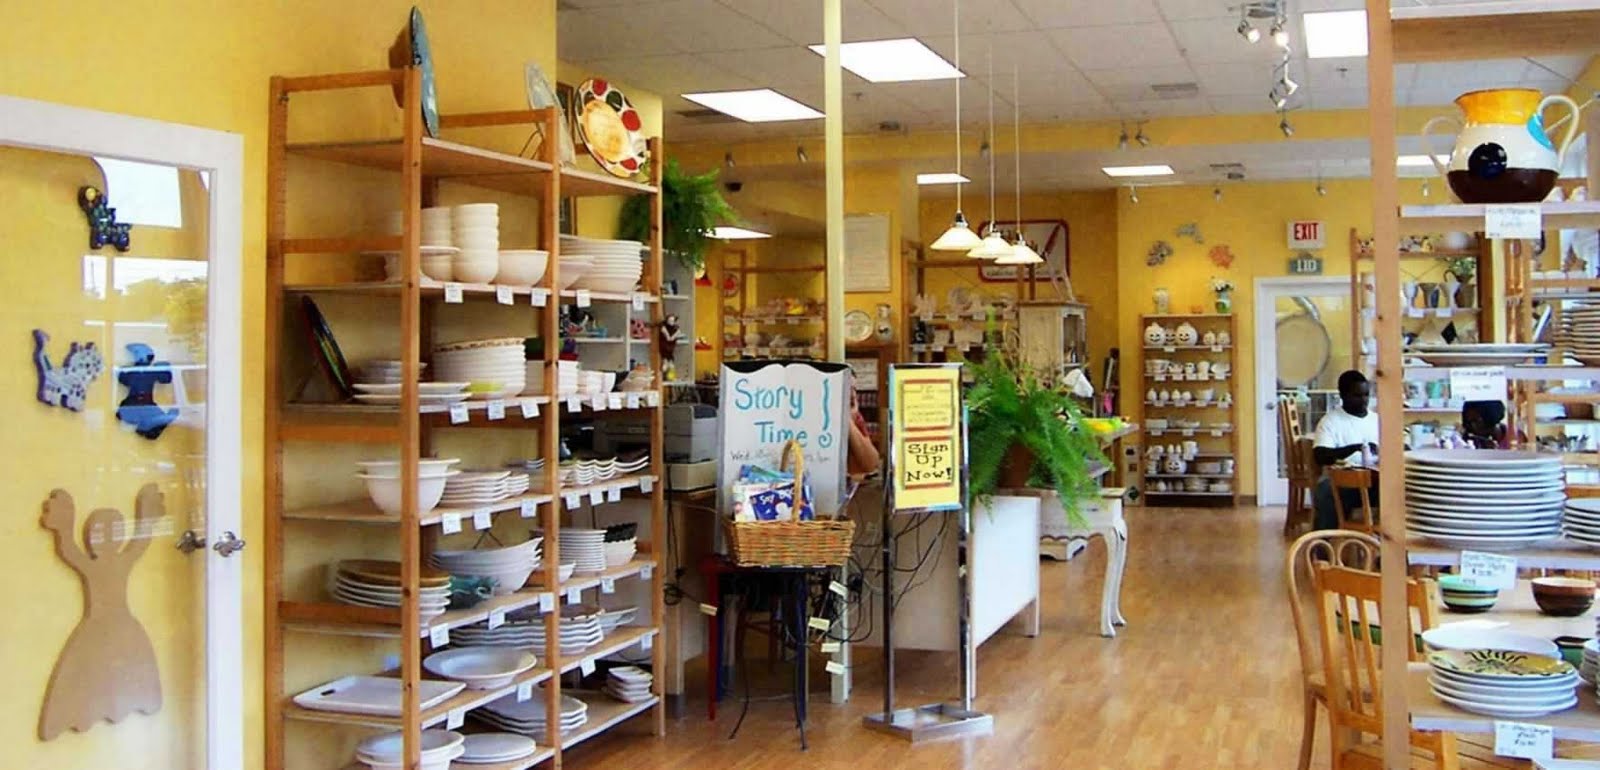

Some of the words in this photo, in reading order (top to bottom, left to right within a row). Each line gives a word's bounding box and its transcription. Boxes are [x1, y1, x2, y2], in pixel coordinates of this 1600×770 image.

[1294, 222, 1319, 240] EXIT
[735, 378, 803, 419] Story
[753, 421, 808, 448] Time
[906, 467, 952, 482] Now!
